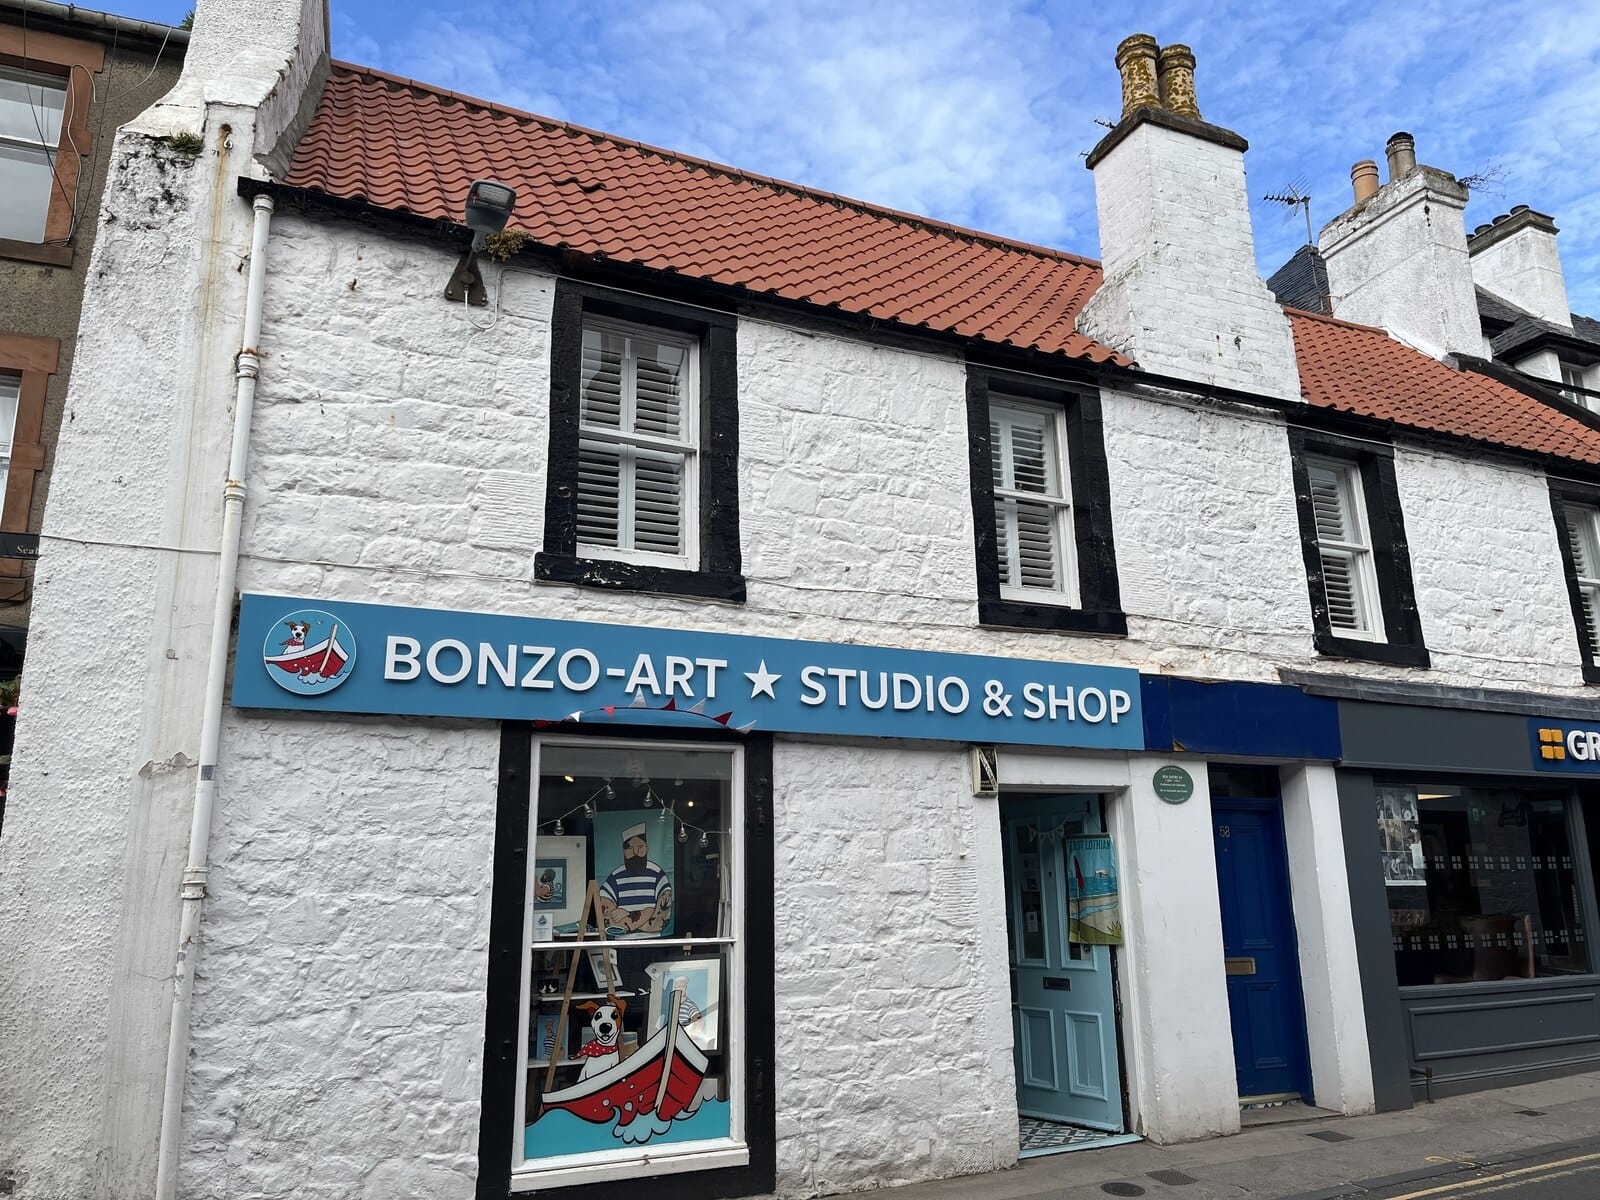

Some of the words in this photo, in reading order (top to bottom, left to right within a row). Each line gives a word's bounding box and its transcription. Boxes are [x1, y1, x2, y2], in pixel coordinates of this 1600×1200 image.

[384, 635, 728, 698] BONZO-ART
[800, 665, 970, 714] STUDIO
[983, 679, 1013, 717] &
[1023, 682, 1131, 723] SHOP
[1085, 839, 1112, 850] LOTHIAN
